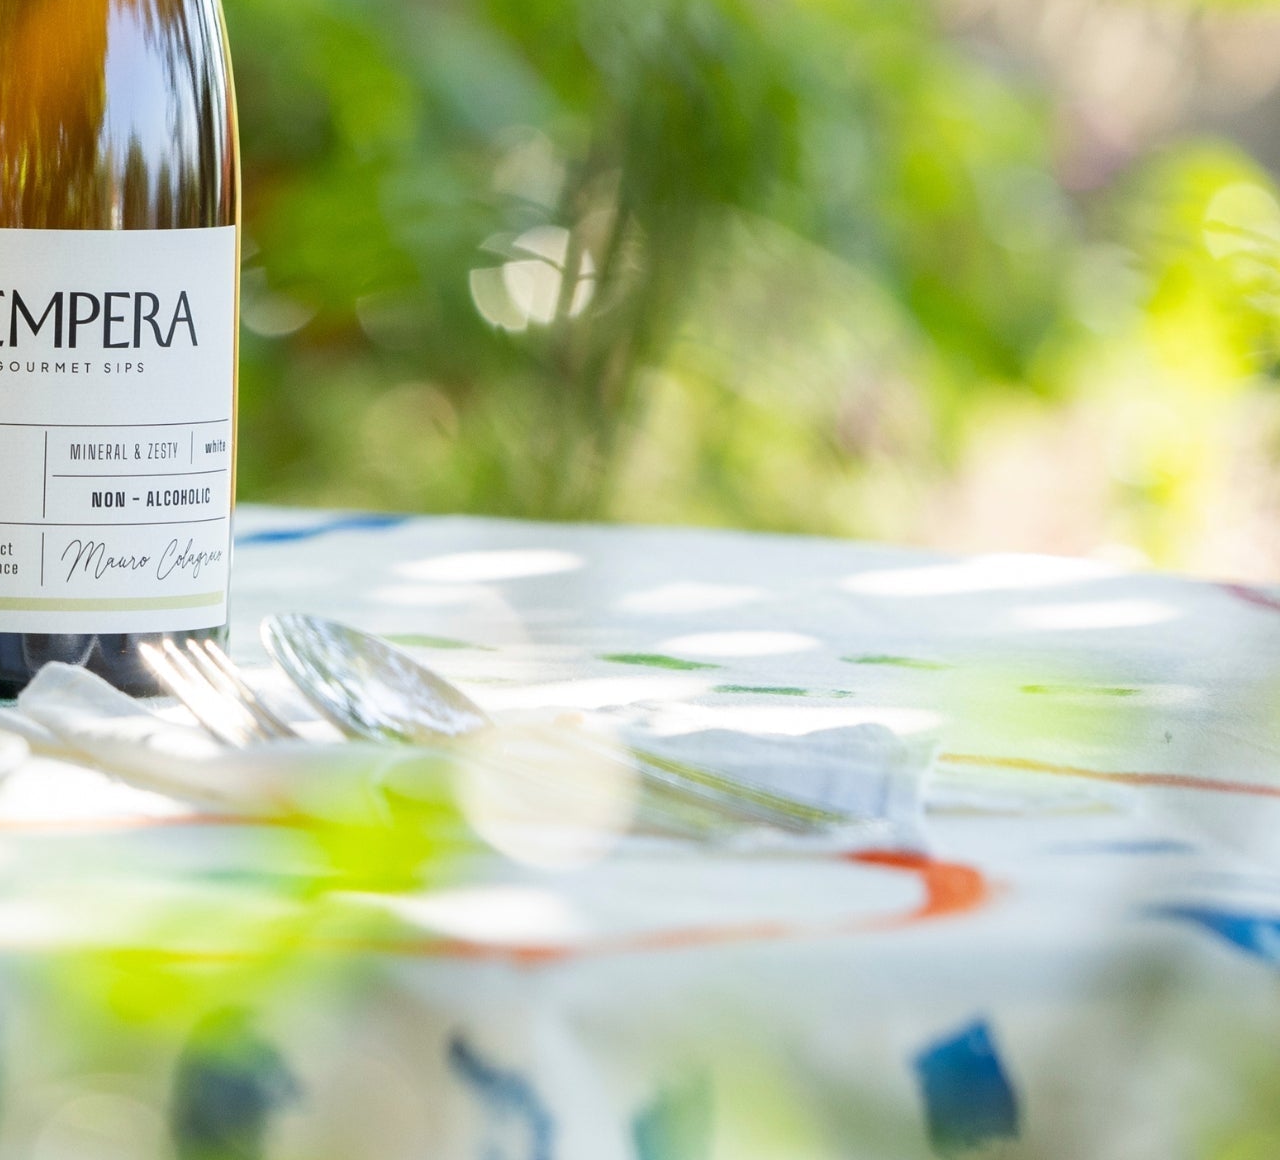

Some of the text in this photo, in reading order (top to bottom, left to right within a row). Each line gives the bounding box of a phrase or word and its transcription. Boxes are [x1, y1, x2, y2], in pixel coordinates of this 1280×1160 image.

[103, 361, 146, 374] SIPS
[69, 442, 179, 460] MINERAL & ZESTY
[204, 439, 226, 454] white
[91, 491, 126, 508] NON
[146, 487, 211, 507] ALCOHOLIC
[60, 539, 151, 583] Mauro
